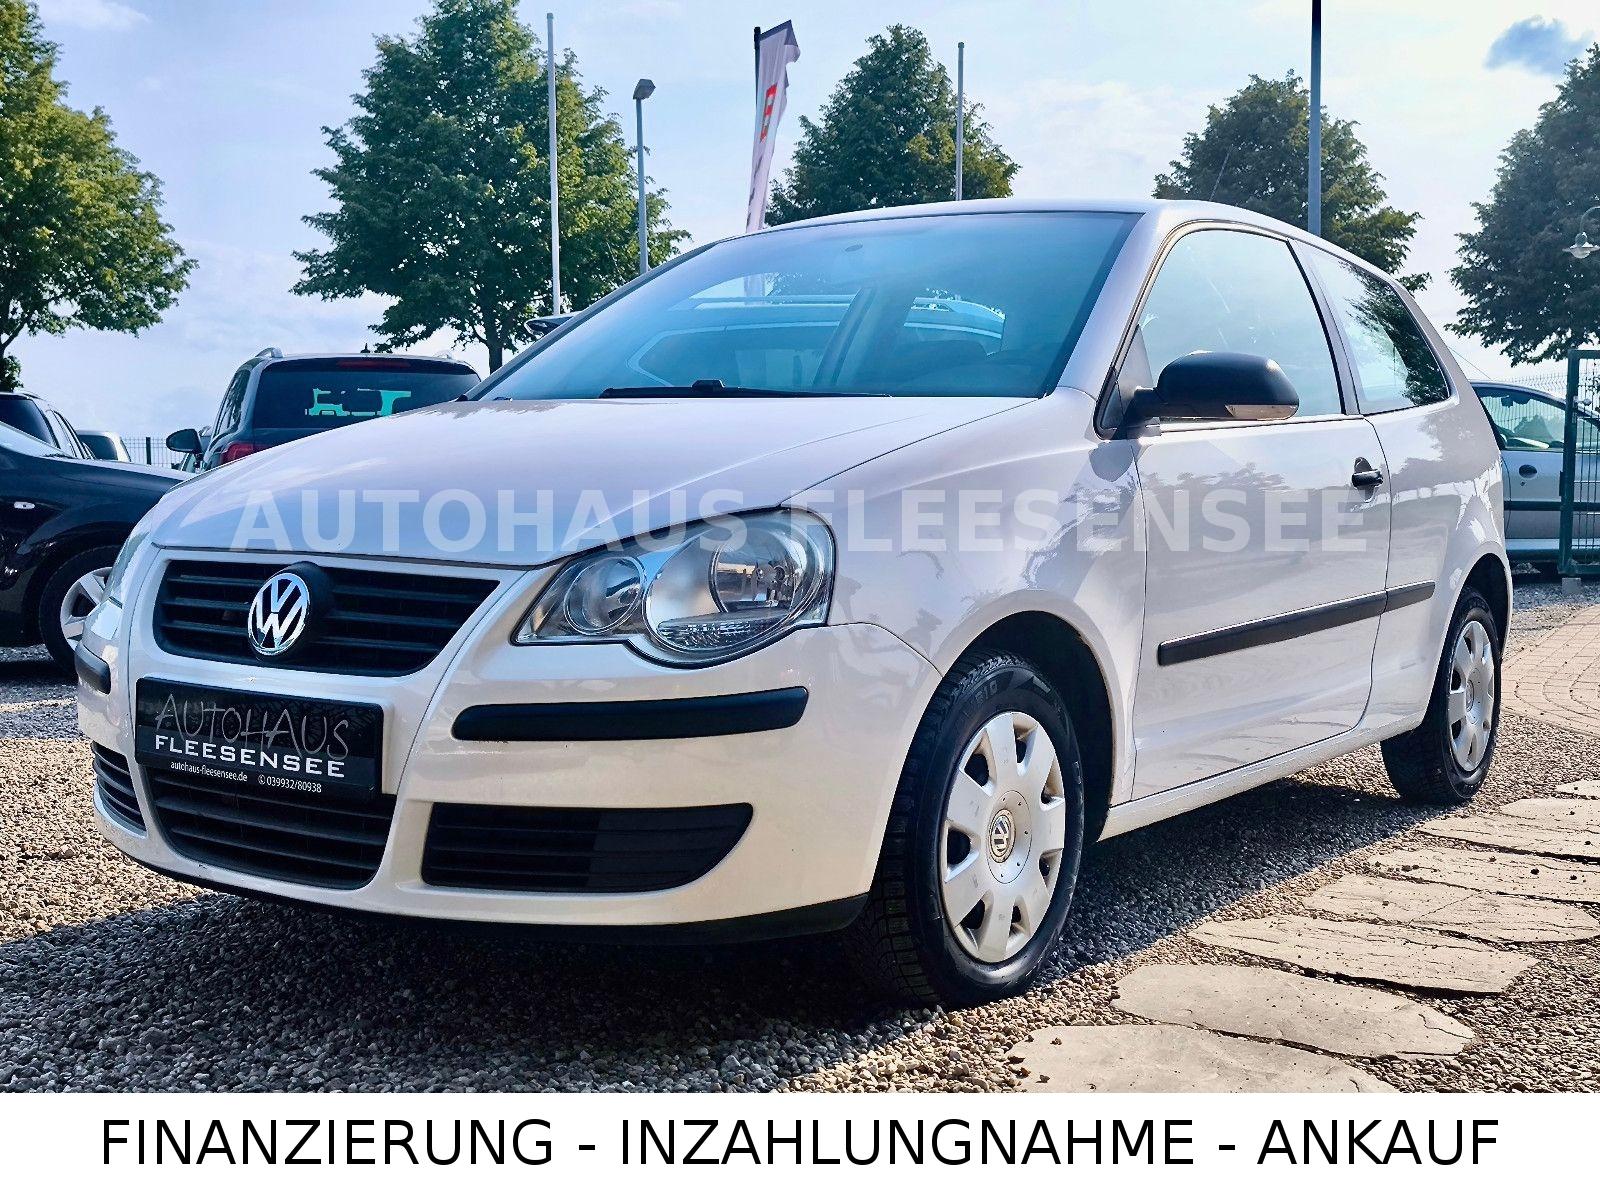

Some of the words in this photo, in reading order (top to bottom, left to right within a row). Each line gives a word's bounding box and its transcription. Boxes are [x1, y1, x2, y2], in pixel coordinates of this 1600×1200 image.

[249, 574, 309, 655] VW
[155, 694, 349, 760] AUTOHAUS
[155, 734, 345, 778] FLEESENSEE
[170, 761, 248, 782] autohaus-fleesensee.de
